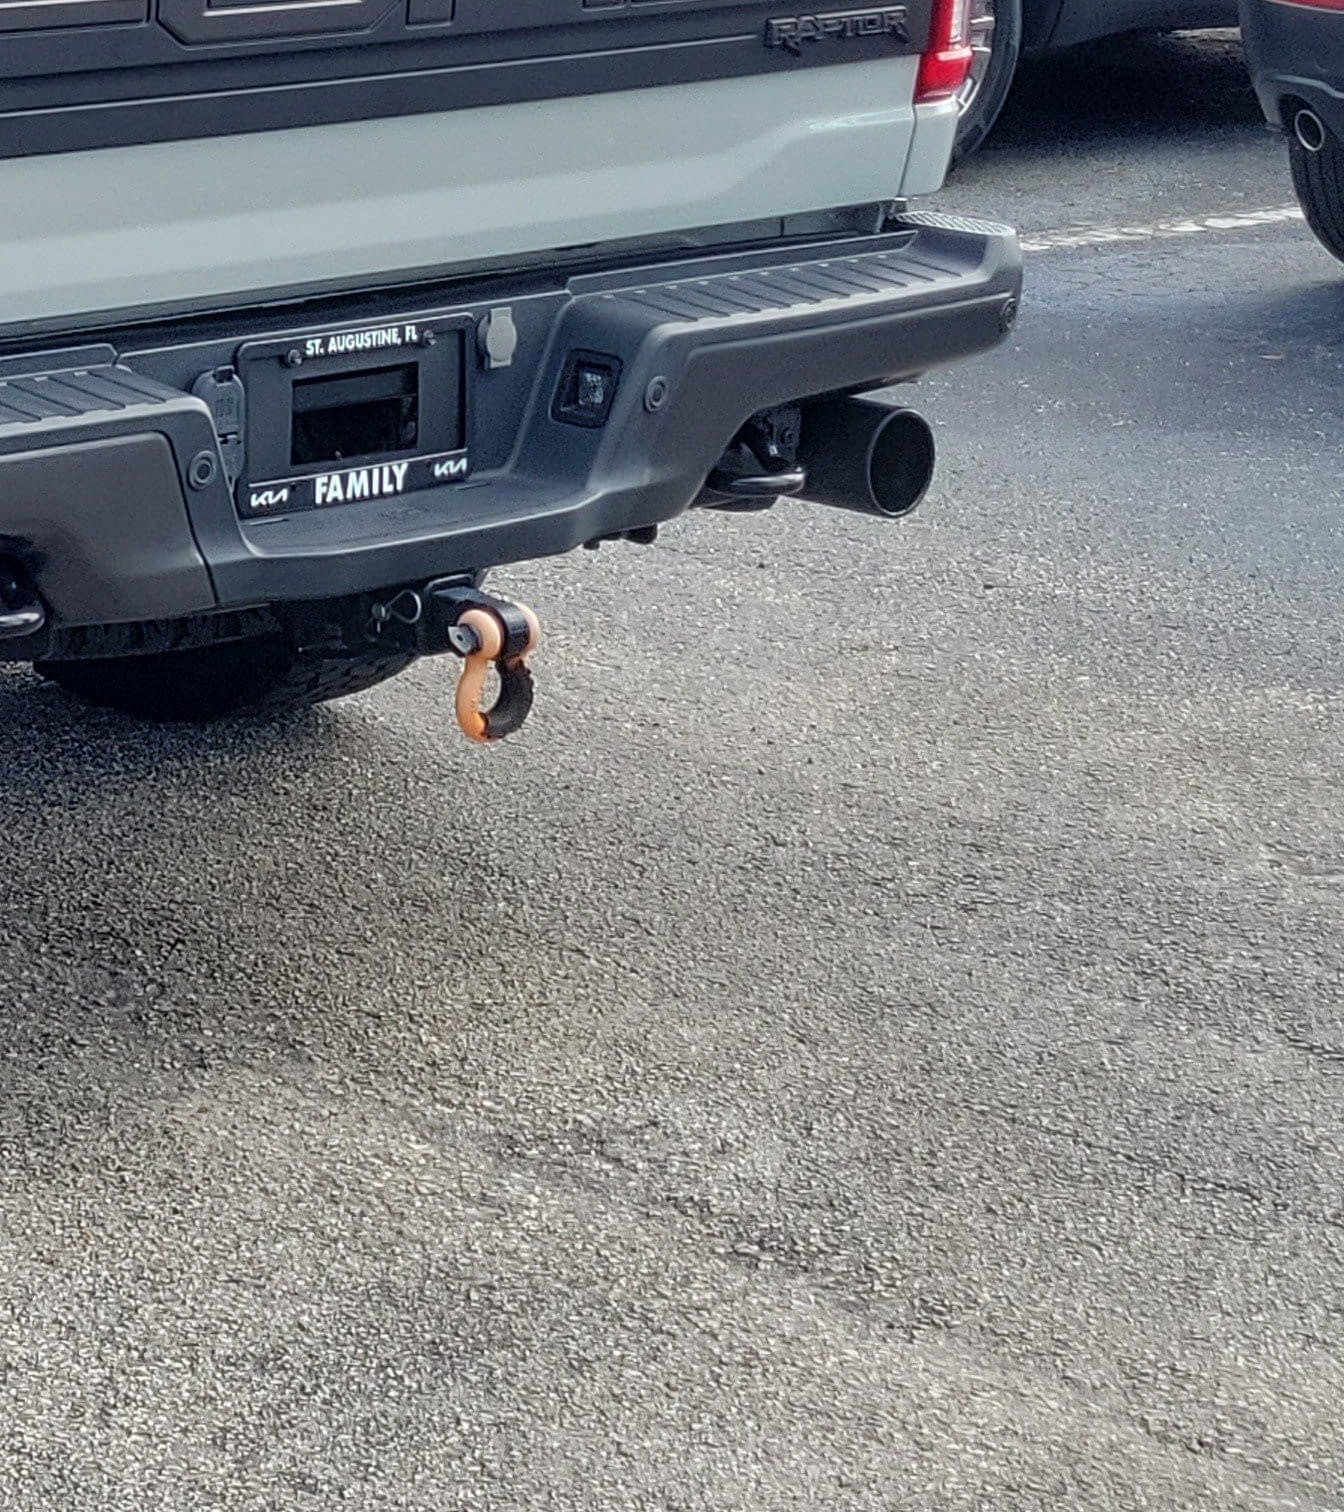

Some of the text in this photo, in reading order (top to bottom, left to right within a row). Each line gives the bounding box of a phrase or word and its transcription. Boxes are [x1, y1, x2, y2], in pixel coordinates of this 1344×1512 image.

[764, 4, 911, 57] RAPTOR
[305, 324, 418, 356] ST. AUGUSTINE, FL
[315, 462, 409, 505] FAMILY
